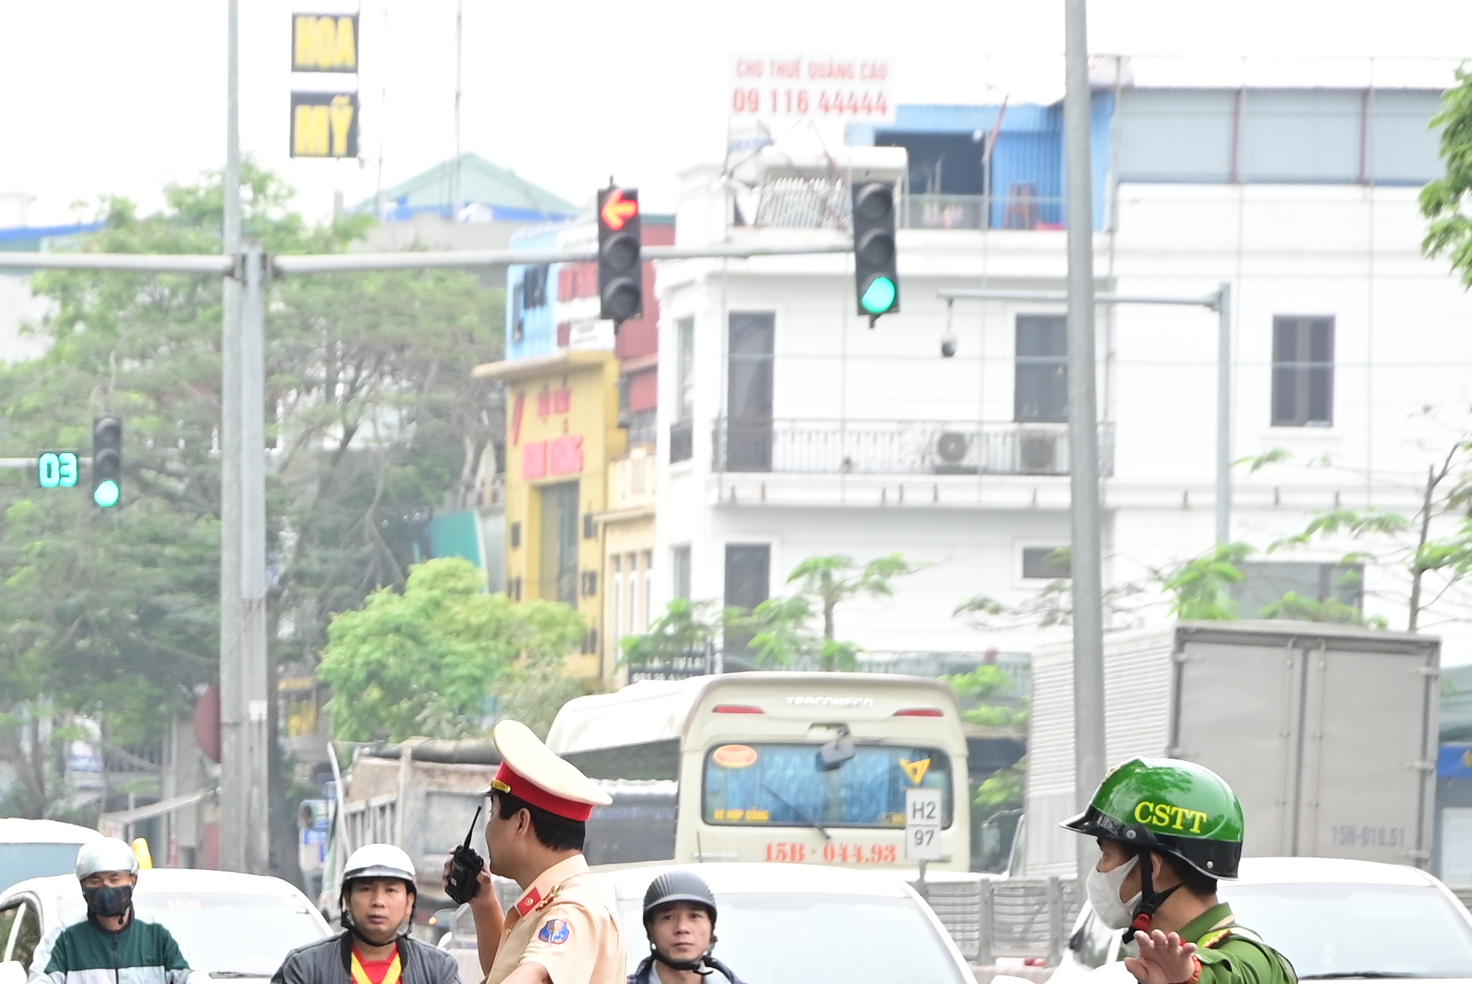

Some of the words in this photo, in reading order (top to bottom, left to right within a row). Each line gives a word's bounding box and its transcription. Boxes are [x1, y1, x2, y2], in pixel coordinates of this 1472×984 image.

[295, 15, 356, 67] HOA
[733, 88, 759, 114] 09
[771, 90, 809, 115] 116
[819, 90, 888, 116] 44444
[294, 95, 355, 157] MỸ
[39, 452, 78, 488] 03
[912, 801, 937, 821] H2
[1134, 801, 1208, 834] CSTT
[914, 829, 935, 847] 97
